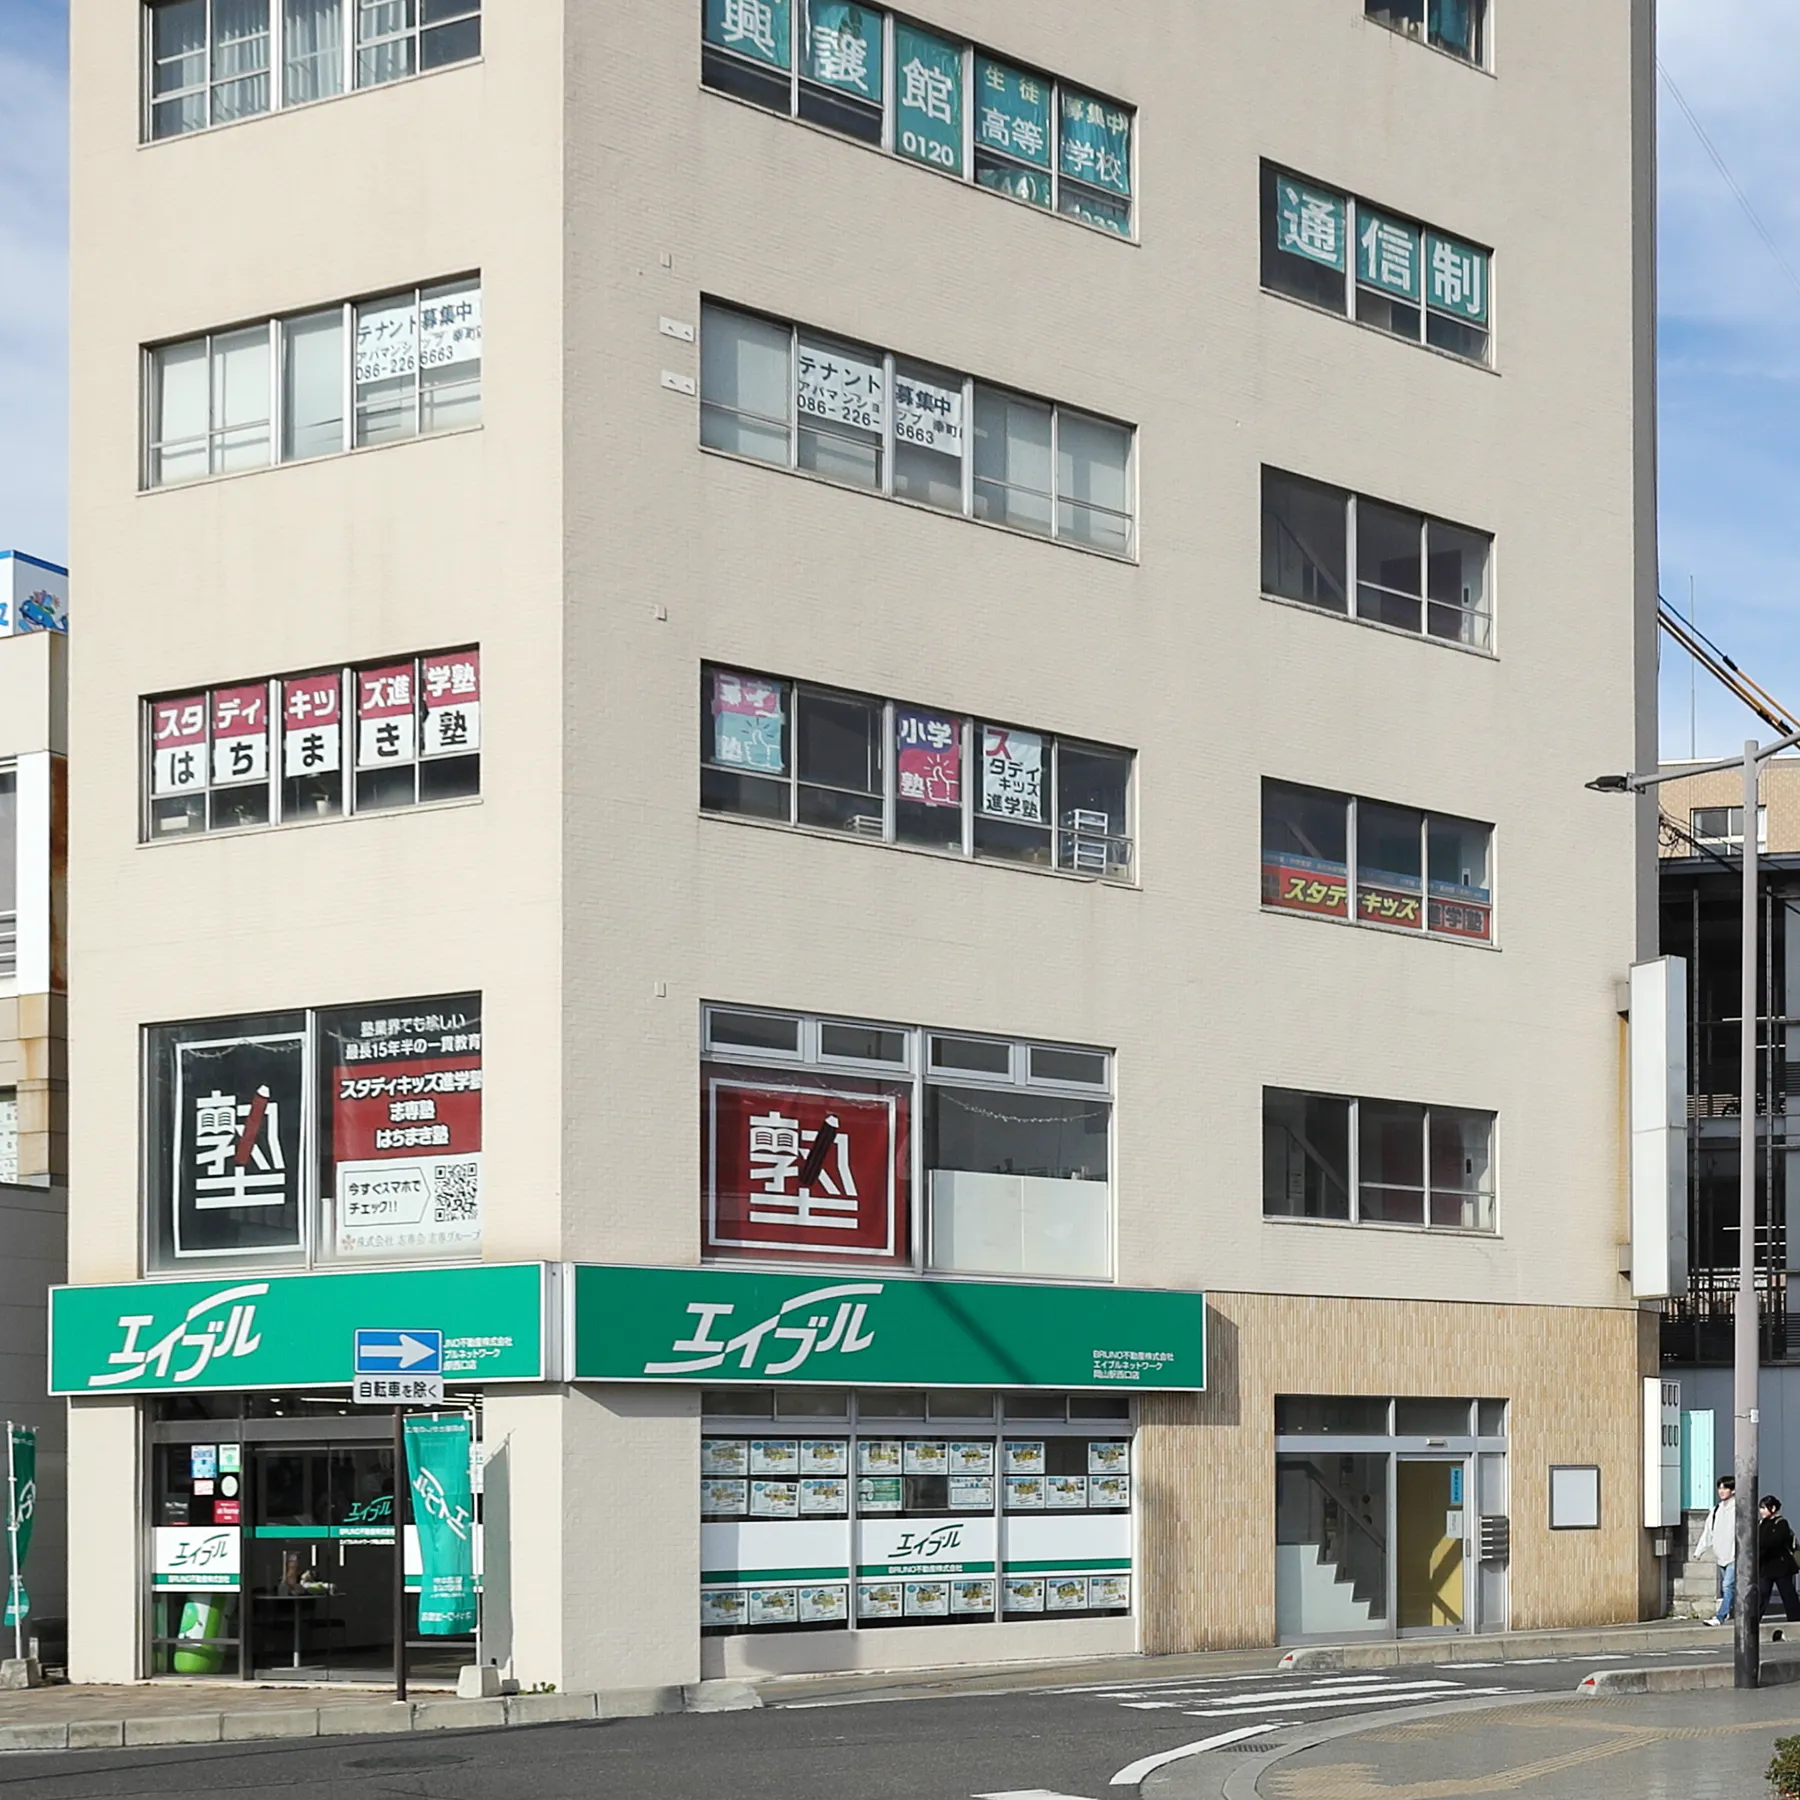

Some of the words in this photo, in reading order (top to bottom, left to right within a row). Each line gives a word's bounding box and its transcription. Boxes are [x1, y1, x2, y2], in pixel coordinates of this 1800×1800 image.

[981, 106, 1124, 188] 高等学校
[1283, 186, 1481, 314] 通信制
[358, 301, 472, 345] テナント募集中
[799, 355, 951, 416] テナント募集中
[170, 711, 468, 785] はちまき塾
[900, 717, 953, 749] 小学
[900, 771, 926, 799] 塾
[986, 793, 1039, 820] 進学塾
[376, 1124, 449, 1149] はちまき塾
[88, 1283, 270, 1387] エイブル
[643, 1283, 884, 1376] エイブル
[1093, 1360, 1163, 1371] エイブルネットワーク
[360, 1381, 437, 1399] 自転車を除く
[343, 1495, 394, 1522] エイブル
[168, 1533, 230, 1567] エイブル
[888, 1523, 964, 1558] エイブル
